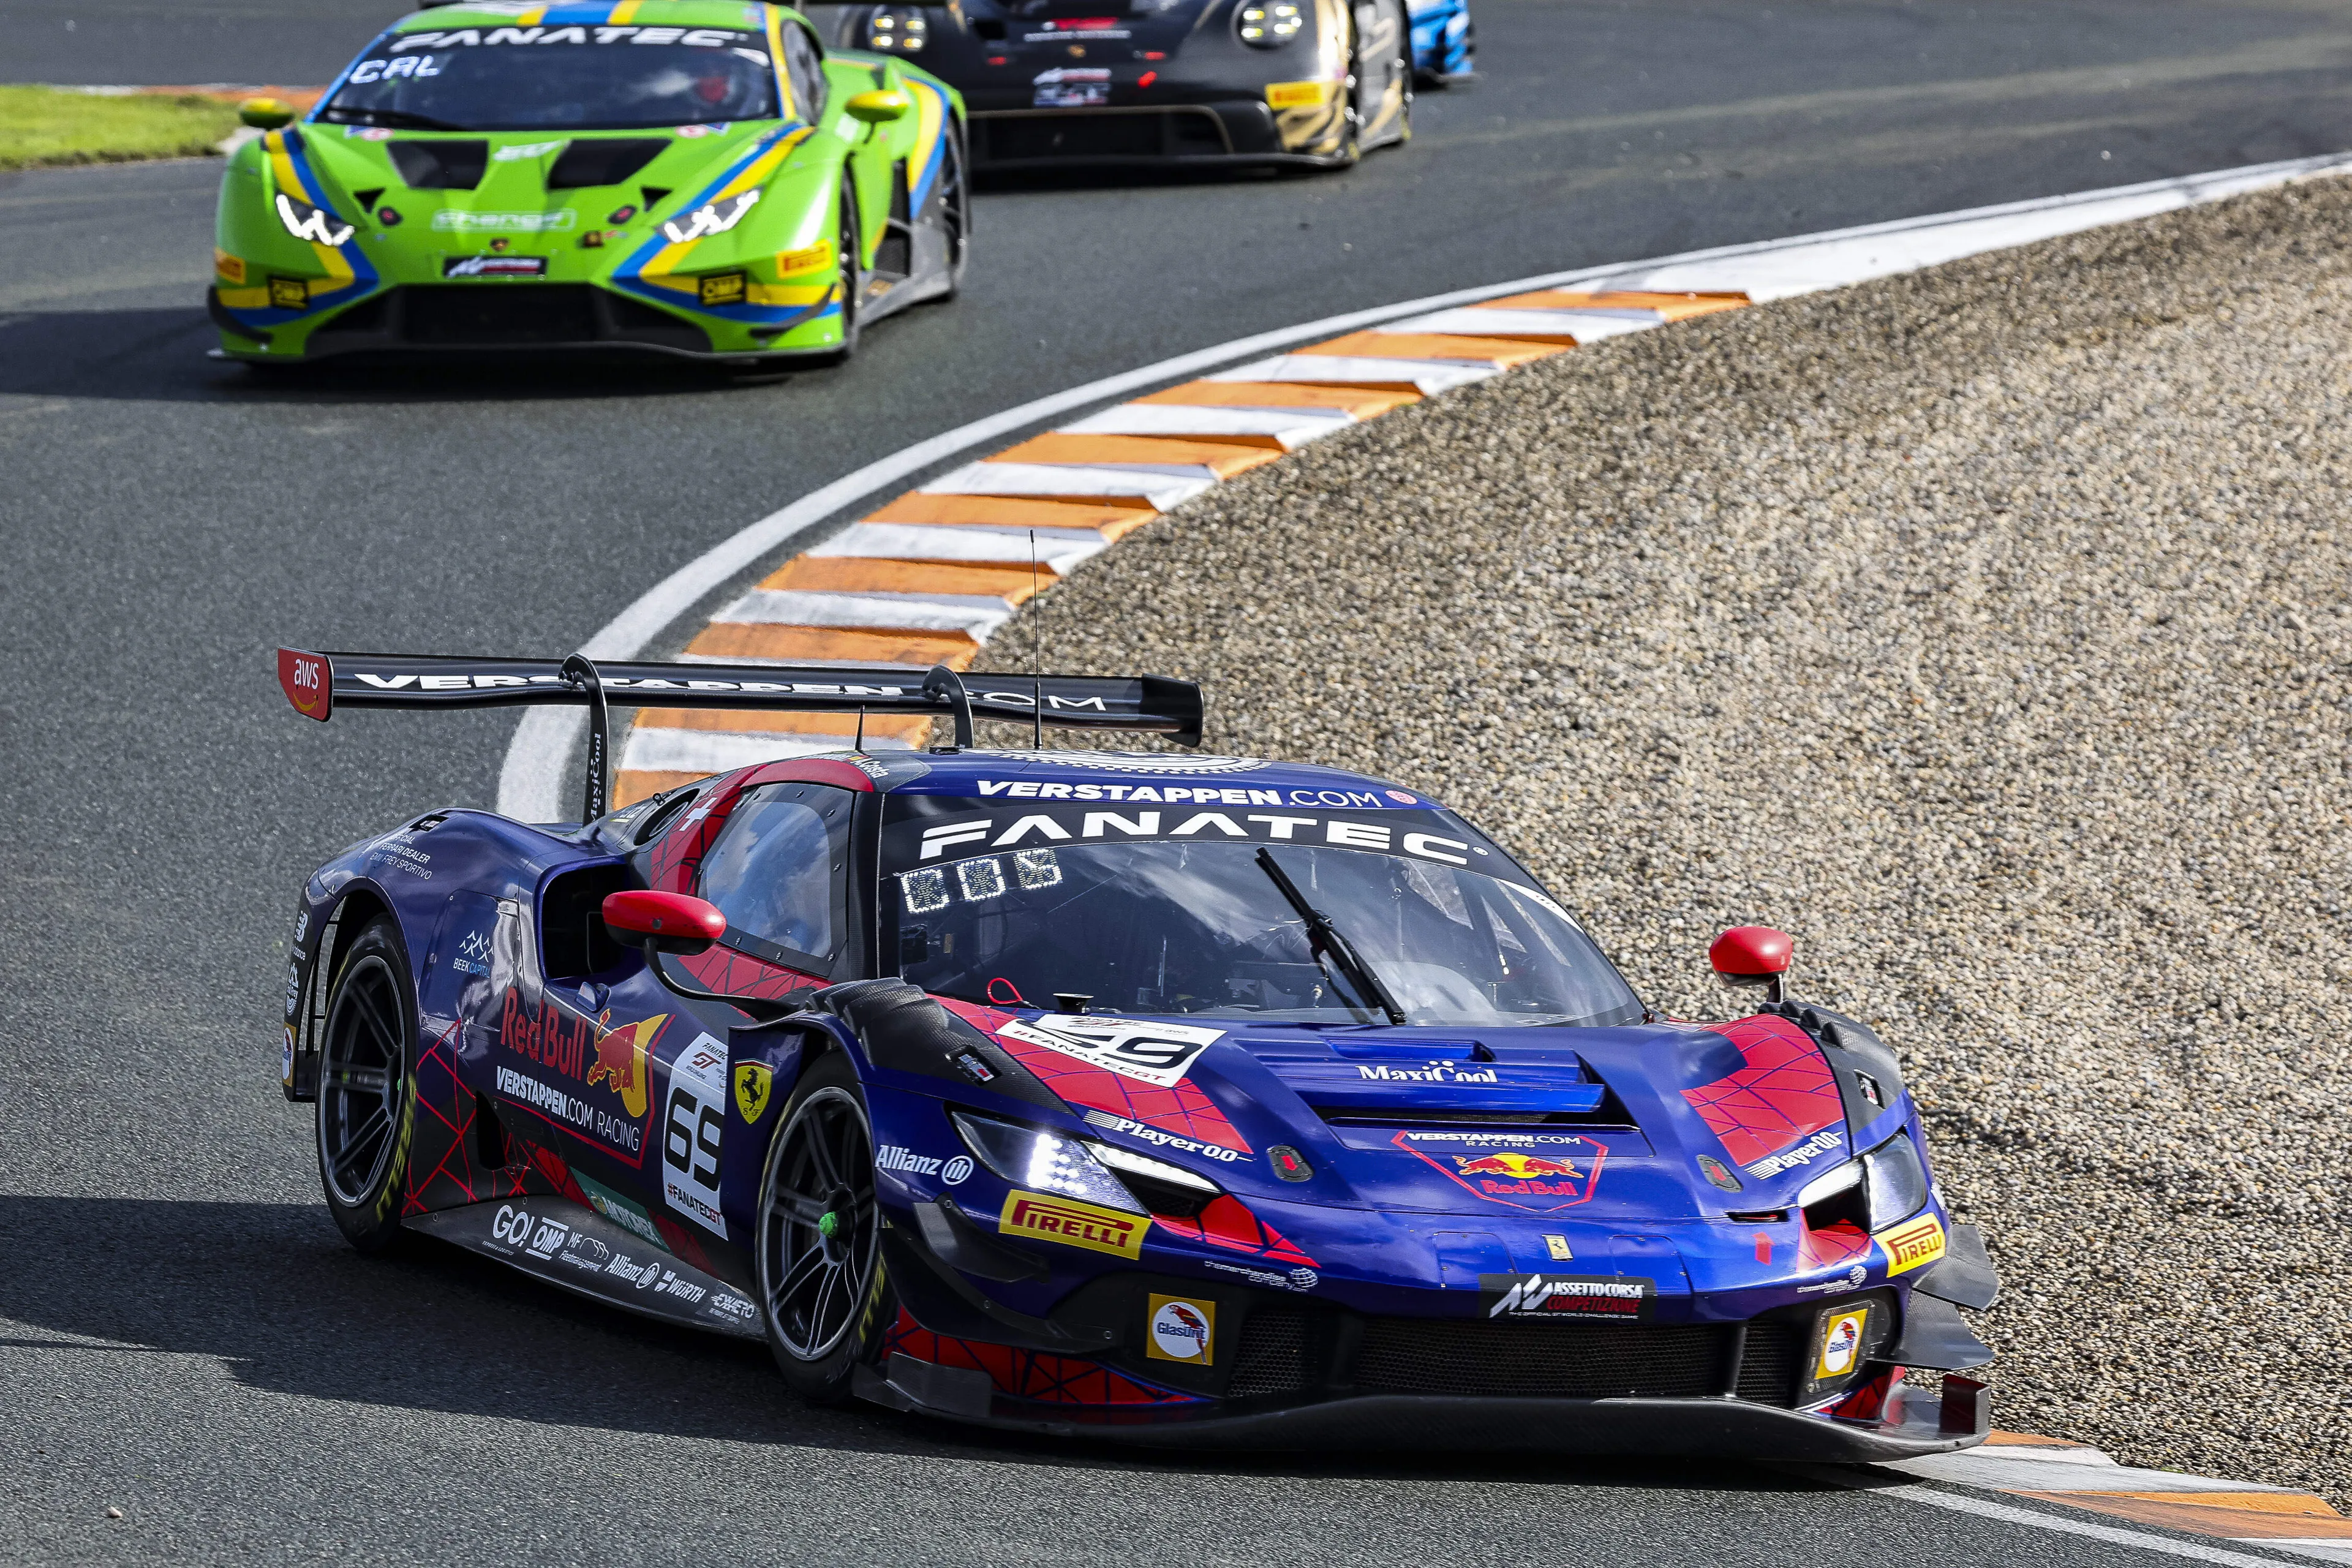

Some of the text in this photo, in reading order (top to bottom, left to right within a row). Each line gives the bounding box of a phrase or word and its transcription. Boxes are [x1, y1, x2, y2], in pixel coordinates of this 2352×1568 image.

[389, 27, 734, 53] FANATEC
[350, 55, 440, 83] CAL
[294, 658, 319, 689] aws
[977, 780, 1383, 807] VERSTAPPEN.COM
[920, 812, 1468, 865] FANATEC
[379, 843, 431, 864] FERRARI DEALER
[382, 854, 399, 865] FREY
[397, 859, 432, 880] SPORTIVO
[501, 986, 587, 1080] Red Bull
[702, 1042, 728, 1060] FANATEC
[1012, 1030, 1167, 1080] #FANATECGT
[497, 1066, 639, 1152] VERSTAPPEN.COM RACING
[664, 1087, 725, 1192] 69
[1407, 1133, 1581, 1145] VERSTAPPEN.COM
[875, 1145, 943, 1175] Allianz
[1480, 1180, 1578, 1196] Red Bull
[668, 1183, 722, 1226] #FANATECGT
[492, 1205, 535, 1247] GO!
[1011, 1199, 1134, 1248] PIRELLI
[533, 1225, 565, 1254] OMP
[567, 1232, 582, 1248] MF
[1887, 1223, 1942, 1266] PIRELLI
[605, 1254, 644, 1281] Allianz
[666, 1278, 707, 1303] WÜRTH
[1546, 1295, 1642, 1313] COMPETIZIONE
[1553, 1282, 1643, 1298] ASSETTO CORSA
